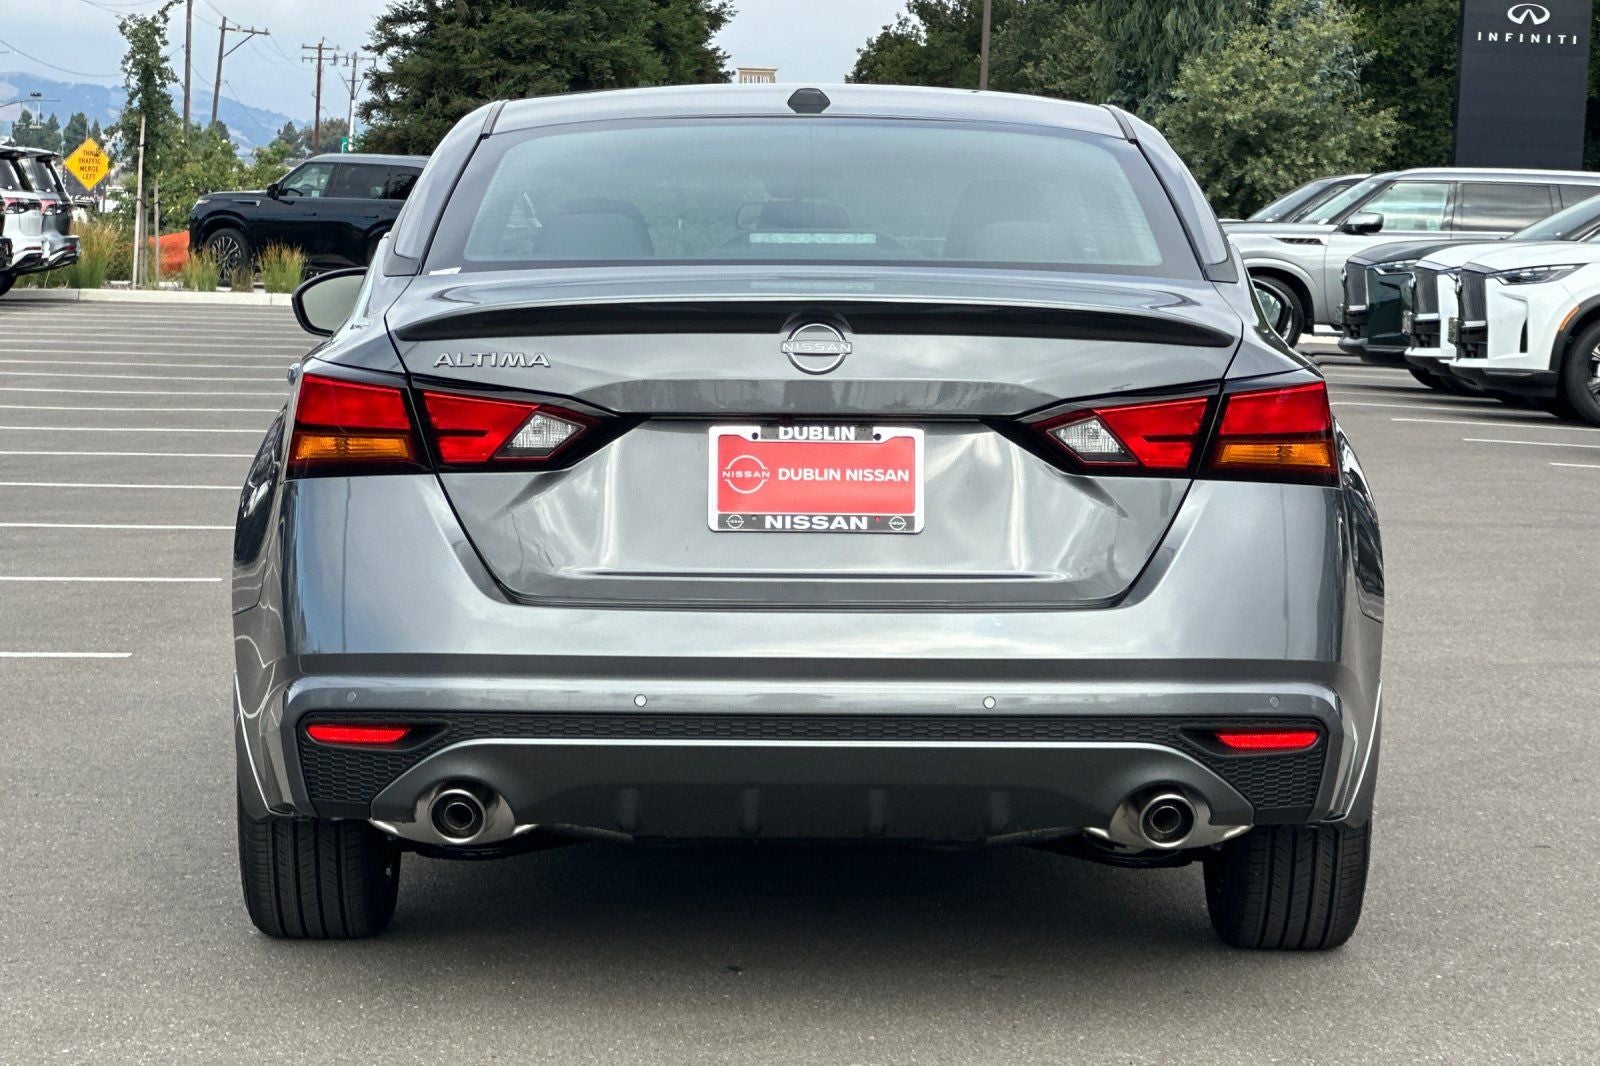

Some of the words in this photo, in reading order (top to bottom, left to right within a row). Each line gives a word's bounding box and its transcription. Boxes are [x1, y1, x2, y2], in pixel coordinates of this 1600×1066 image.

[1478, 31, 1577, 45] INFINITI
[79, 157, 101, 165] TRAFFIC
[80, 165, 98, 173] MERGE
[782, 342, 851, 352] NISSAN
[433, 352, 550, 368] ALTIMA
[778, 426, 855, 441] DUBLIN
[722, 470, 770, 478] NISSAN
[778, 468, 841, 481] DUBLIN
[845, 469, 909, 482] NISSAN
[764, 515, 868, 530] NISSAN
